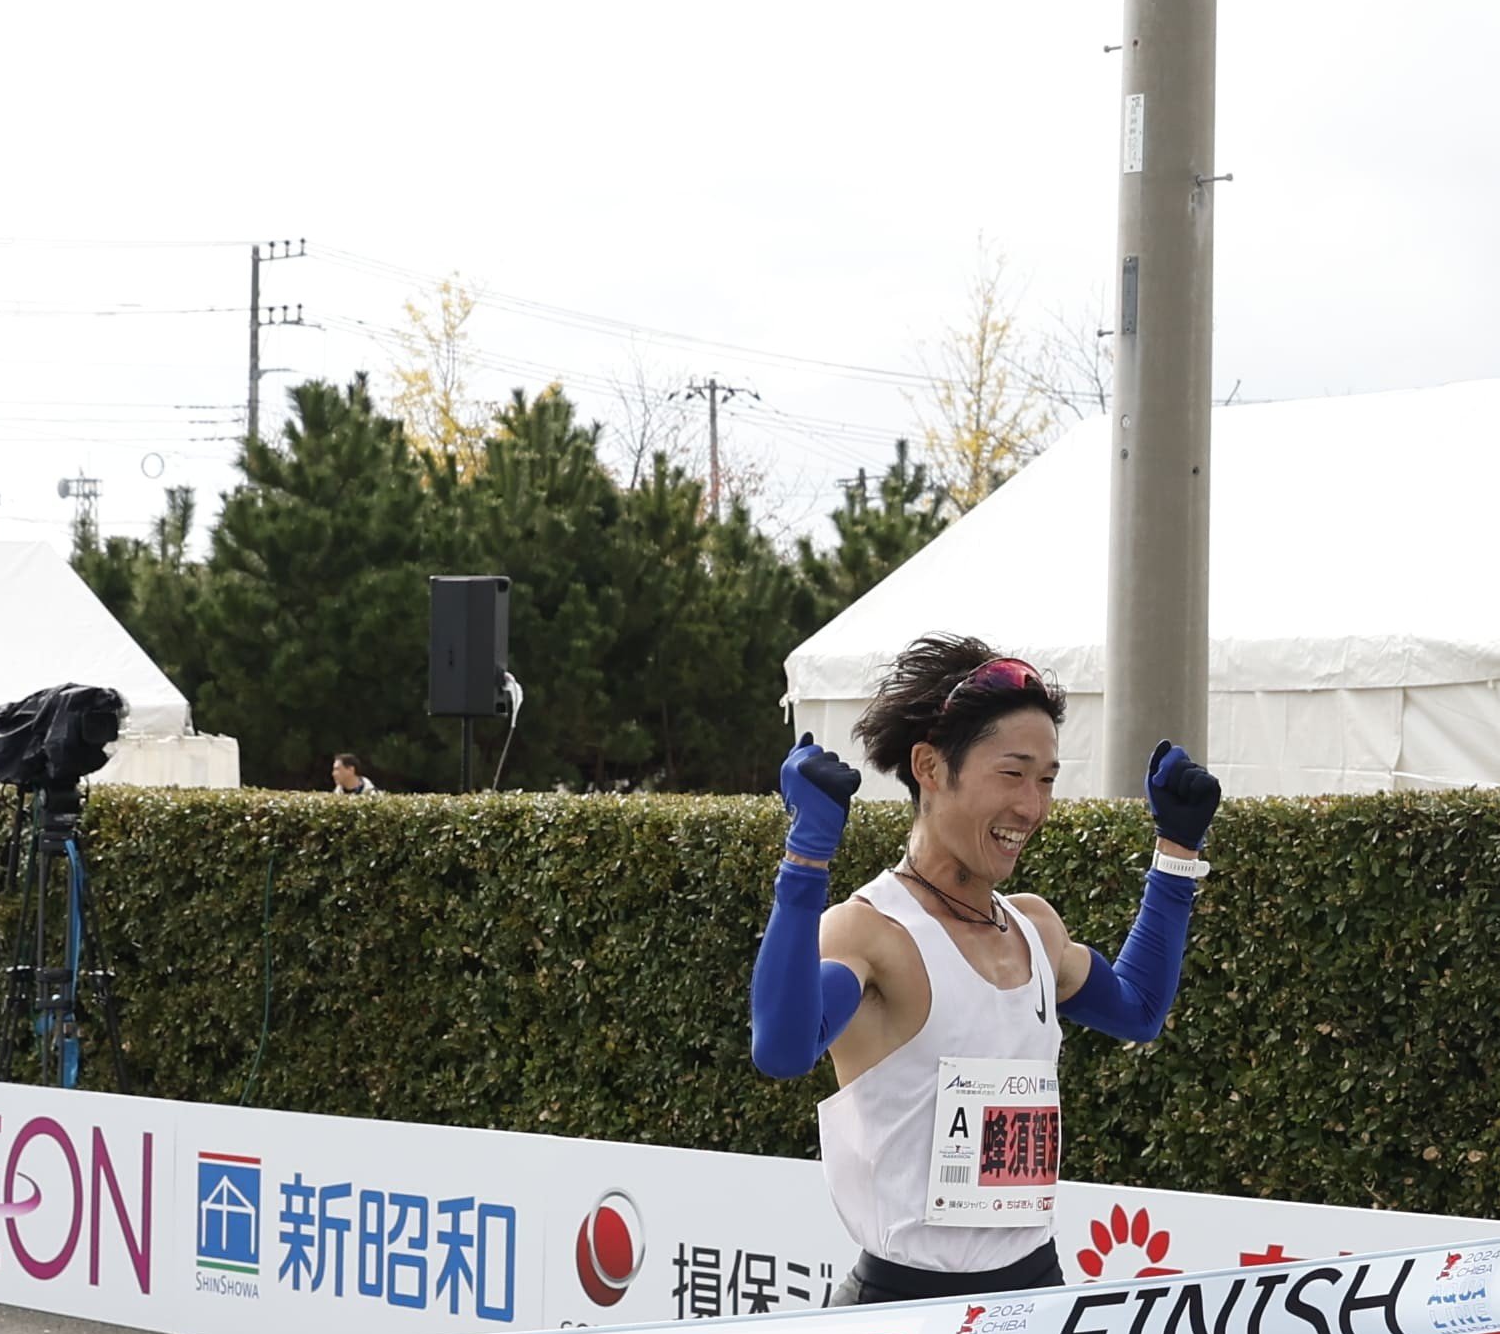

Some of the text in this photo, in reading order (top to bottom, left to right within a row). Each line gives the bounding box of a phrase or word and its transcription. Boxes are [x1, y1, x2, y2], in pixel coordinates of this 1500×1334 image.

[949, 1107, 969, 1138] A
[278, 1172, 515, 1322] 新昭和
[1463, 1249, 1500, 1263] 2024
[1457, 1264, 1493, 1277] CHIBA
[989, 1303, 1034, 1318] 2024
[982, 1319, 1027, 1333] CHIBA
